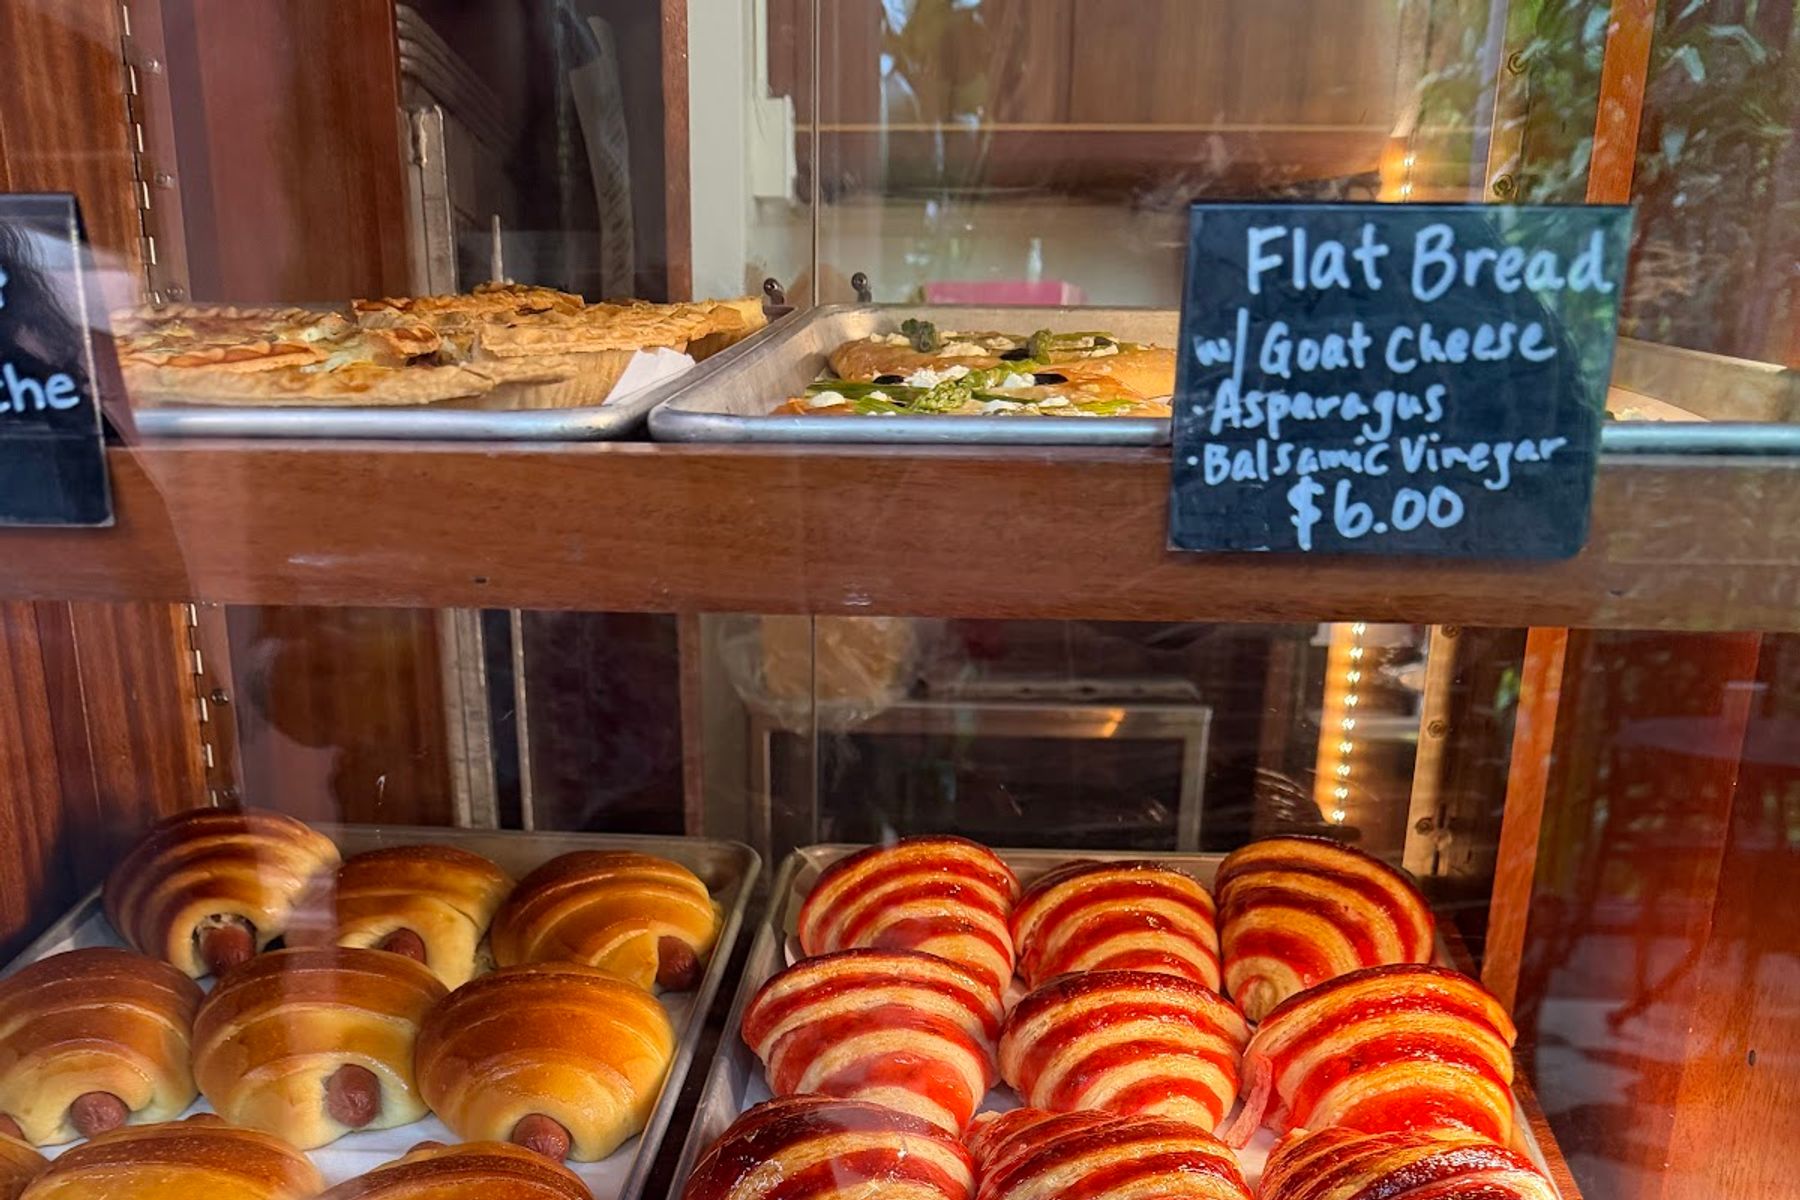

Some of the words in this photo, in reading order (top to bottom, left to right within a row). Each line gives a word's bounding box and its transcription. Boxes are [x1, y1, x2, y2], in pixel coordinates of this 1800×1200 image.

[1246, 223, 1389, 294] Flat
[1411, 224, 1615, 302] Bread
[1259, 321, 1371, 378] Goat
[1386, 323, 1557, 374] Cheese
[1400, 433, 1568, 490] Vinegar
[1287, 476, 1465, 552] $6.00
